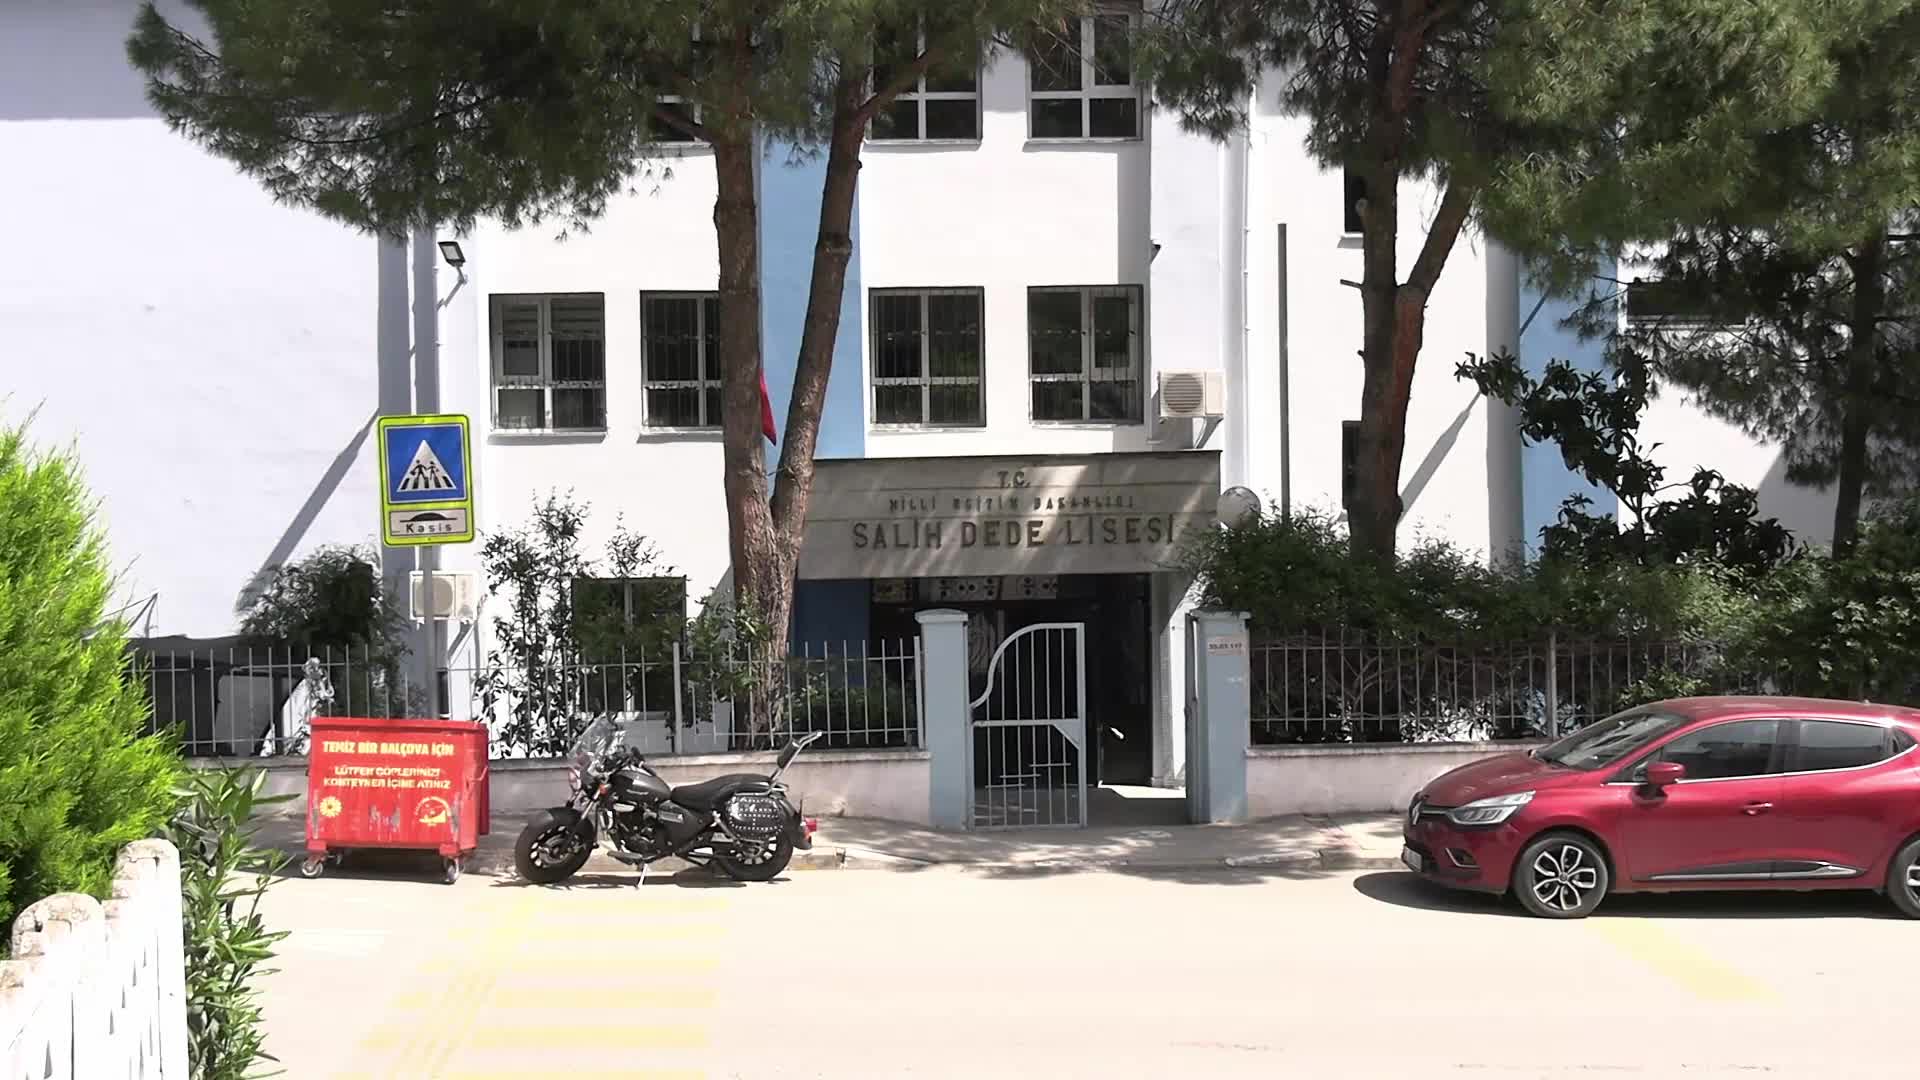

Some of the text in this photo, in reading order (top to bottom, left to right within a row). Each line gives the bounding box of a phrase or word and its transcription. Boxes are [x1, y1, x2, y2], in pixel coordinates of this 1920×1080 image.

[997, 470, 1031, 489] T.C.
[406, 523, 452, 533] Kasis
[853, 513, 1174, 549] SALİH DEDE LİSESİ
[322, 740, 356, 753] TEMİZ
[358, 741, 378, 754] BİR
[380, 742, 429, 757] BALÇOVA
